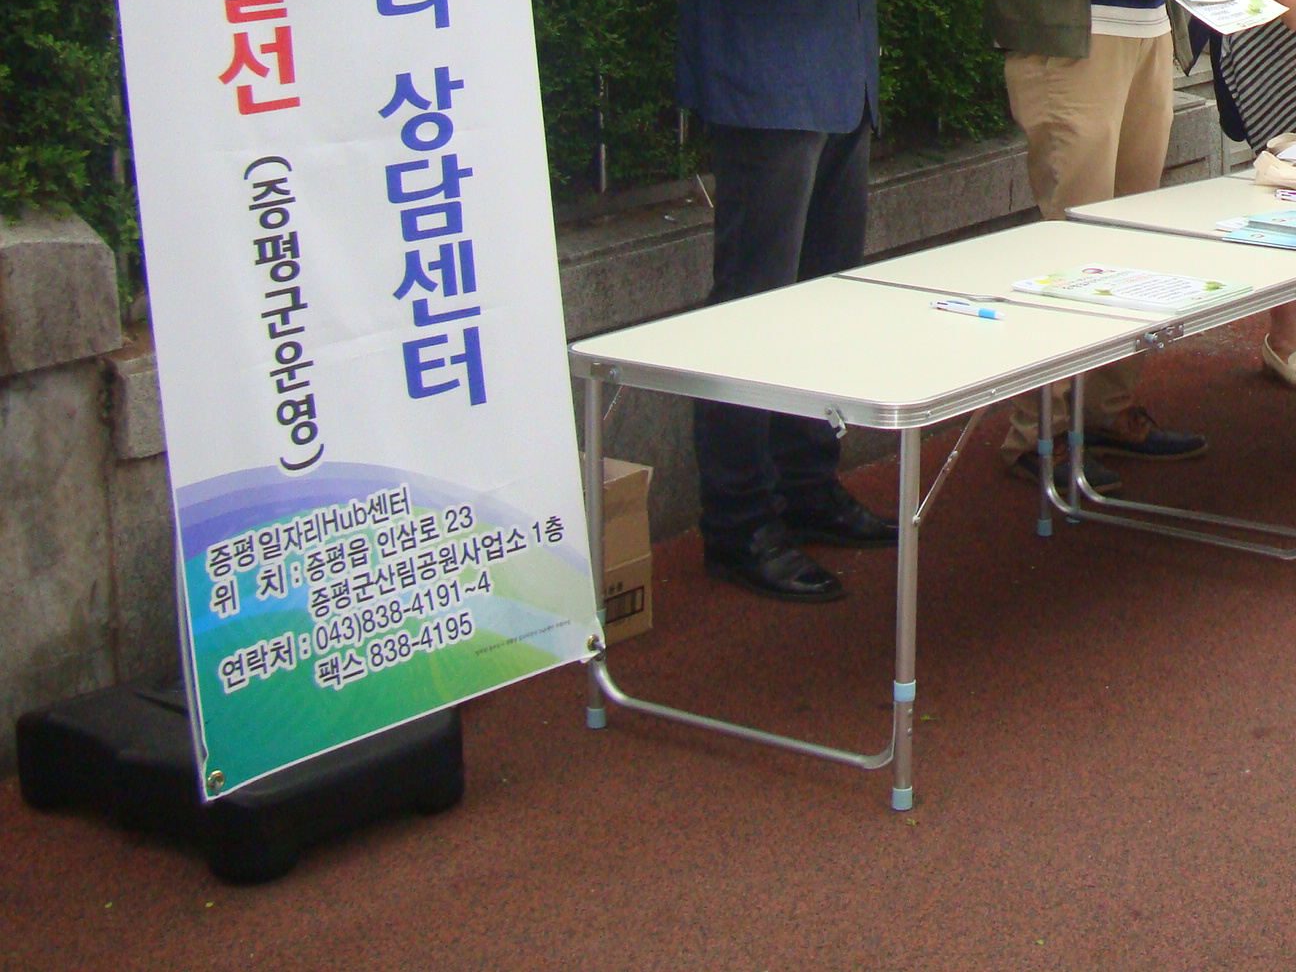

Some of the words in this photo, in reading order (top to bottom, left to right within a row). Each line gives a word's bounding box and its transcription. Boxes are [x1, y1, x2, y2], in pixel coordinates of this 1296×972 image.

[378, 66, 487, 407] 상담센터
[243, 156, 325, 471] (증평군운영)
[305, 538, 370, 581] 증평읍
[377, 516, 440, 558] 인삼로
[445, 506, 473, 531] 23
[311, 530, 526, 618] 증평군산림공원사업소
[532, 516, 564, 545] 1층
[222, 639, 293, 688] 연락처
[316, 571, 491, 651] 043)838-4191~4
[317, 652, 364, 687] 팩스
[371, 613, 473, 667] 838-4195
